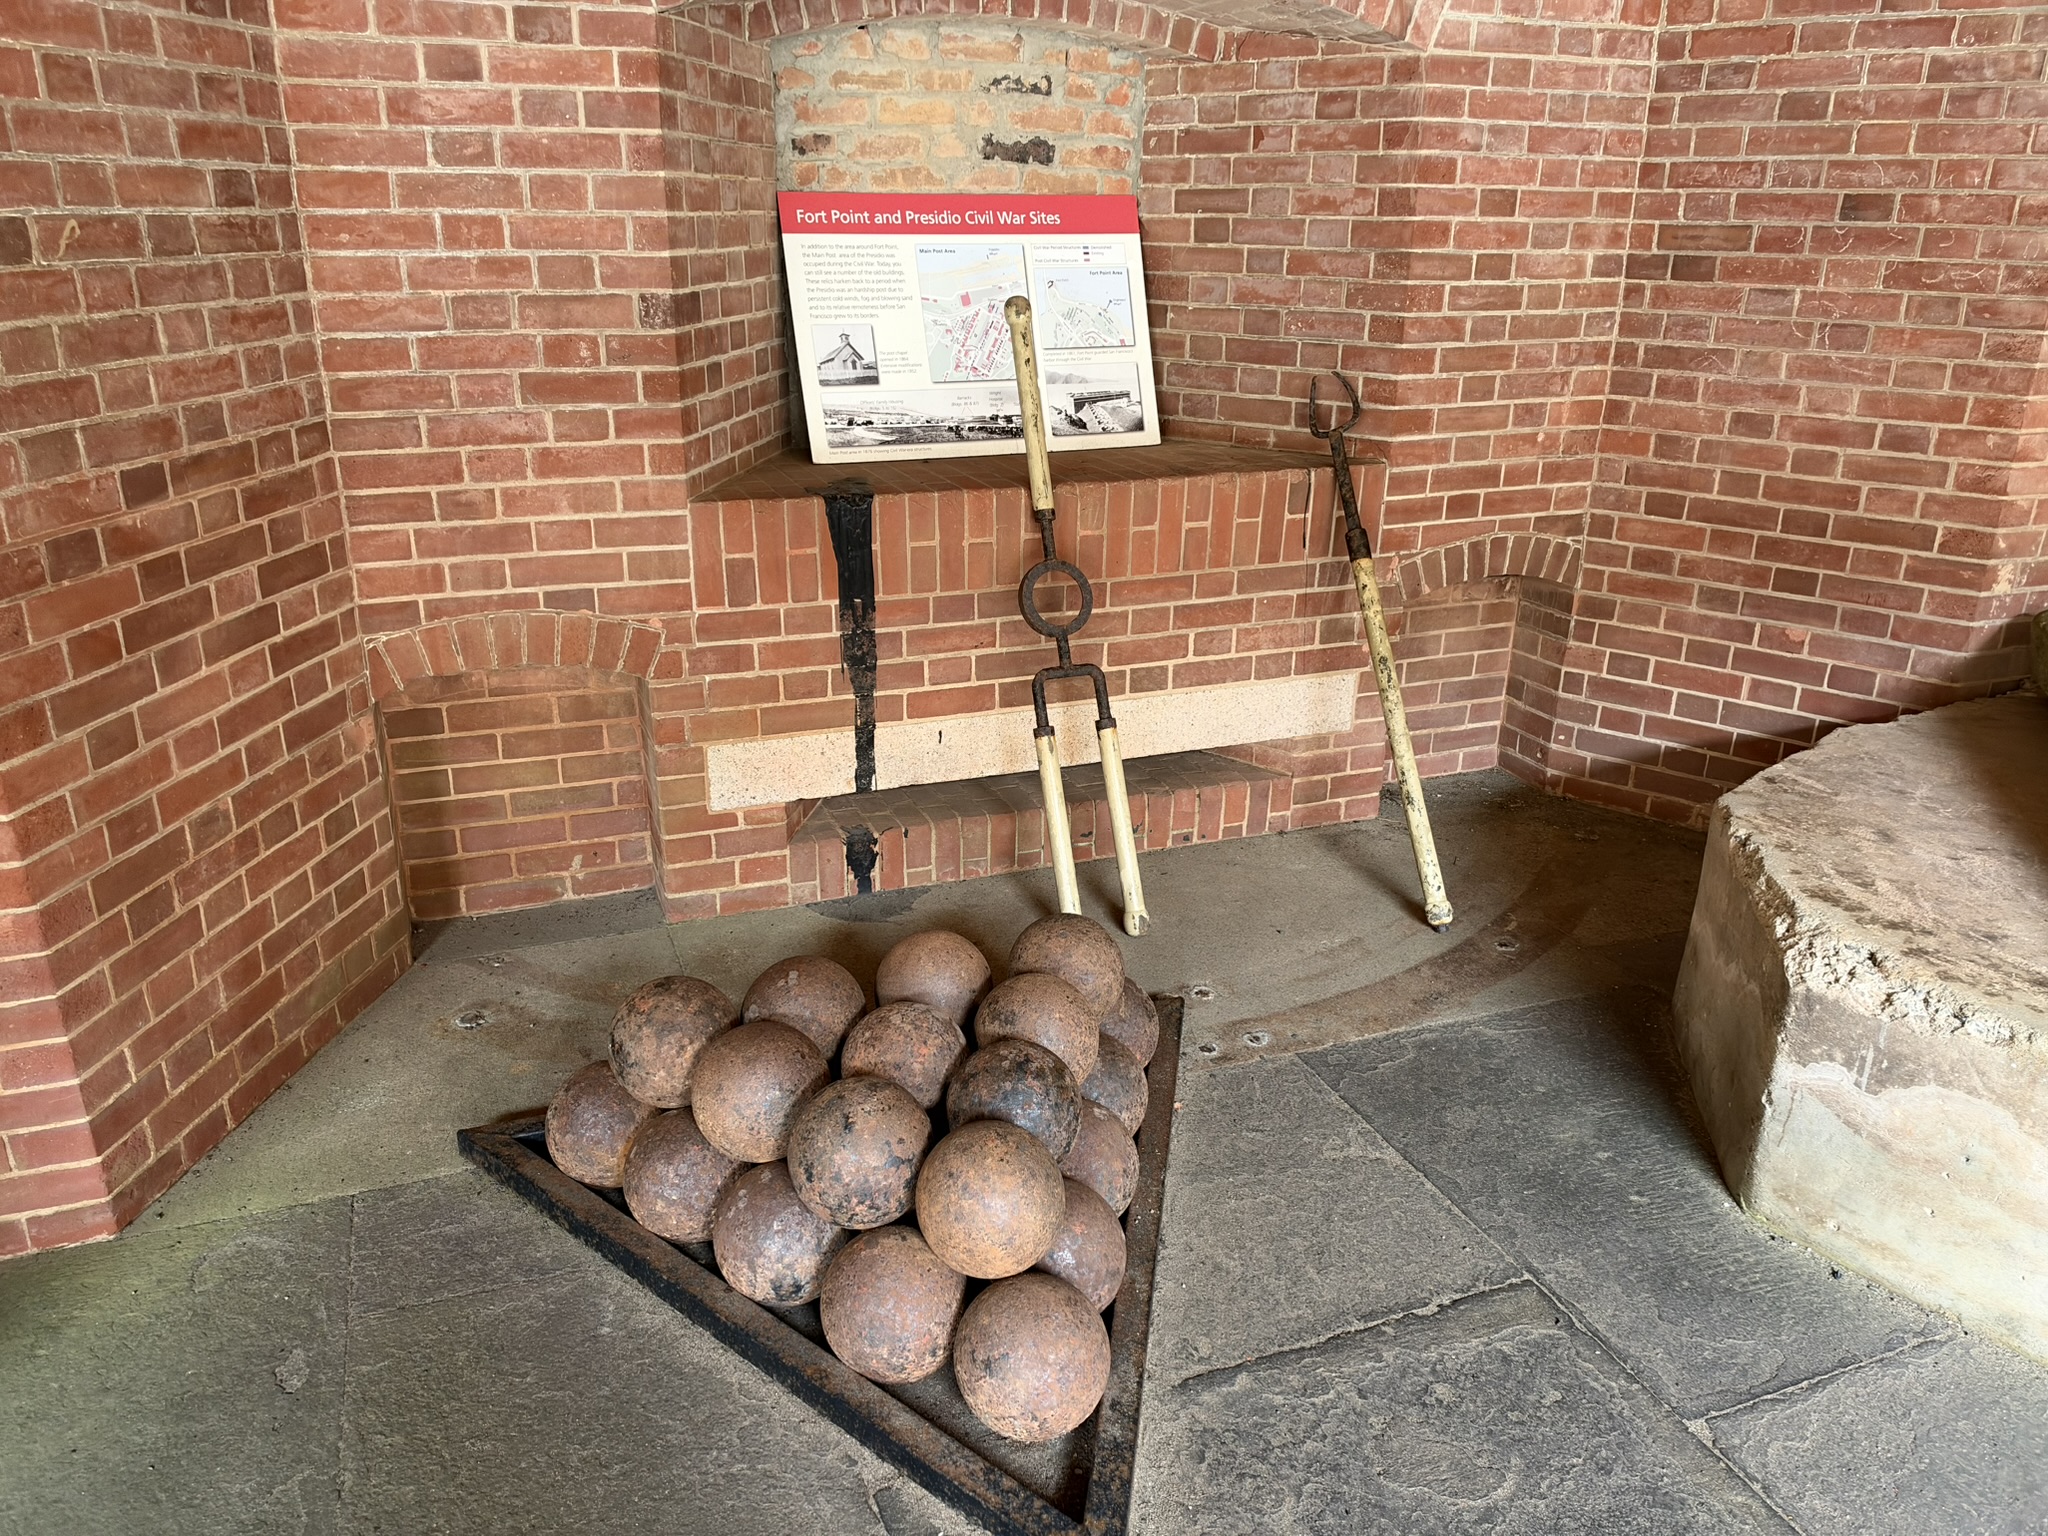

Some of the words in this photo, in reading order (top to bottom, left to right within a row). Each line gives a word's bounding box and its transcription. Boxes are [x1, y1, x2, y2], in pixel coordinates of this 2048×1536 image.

[796, 209, 827, 223] Fort
[831, 209, 870, 224] Point
[874, 210, 901, 224] and
[906, 210, 961, 224] Presidio
[964, 210, 994, 224] Civil
[997, 211, 1025, 224] War
[1030, 211, 1061, 224] Sites
